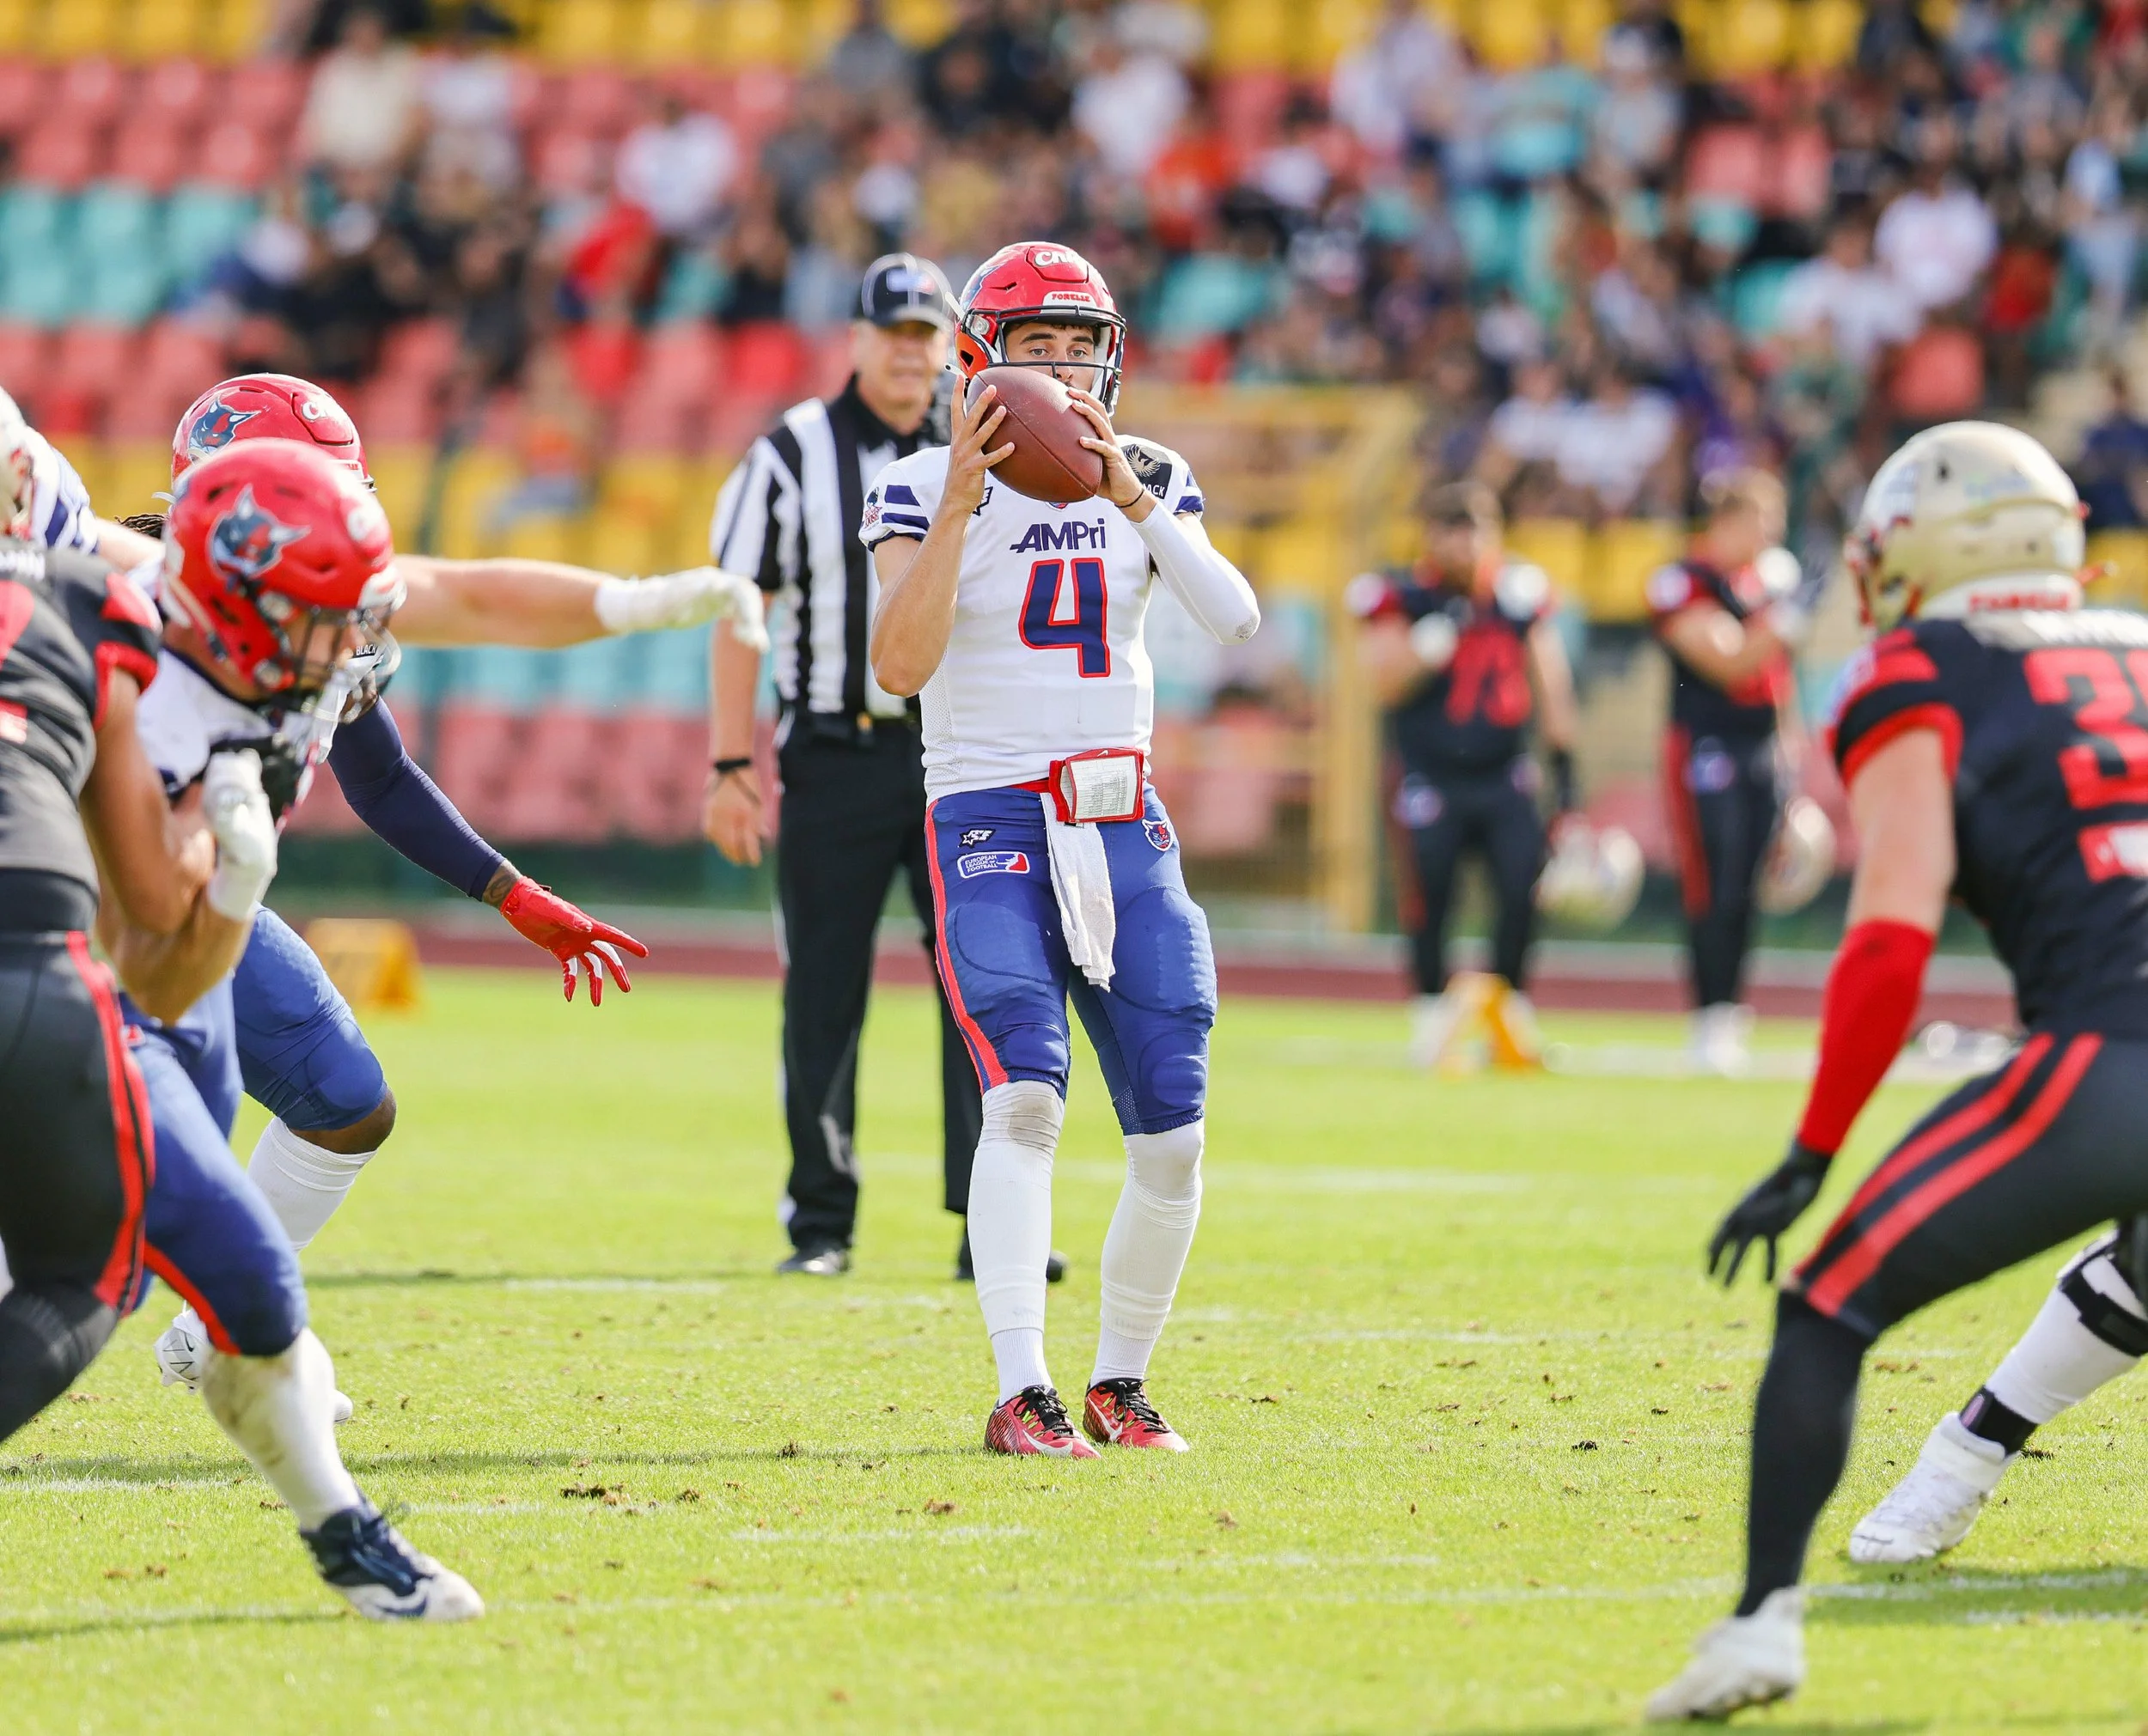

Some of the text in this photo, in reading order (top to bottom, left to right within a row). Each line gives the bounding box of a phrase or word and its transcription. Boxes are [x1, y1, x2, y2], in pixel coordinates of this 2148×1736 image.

[1010, 518, 1106, 553] AMPri
[1018, 557, 1111, 678] 4
[965, 855, 998, 864] EUROPEAN
[966, 860, 989, 868] LEAGUE
[967, 862, 998, 873] FOOTBALL
